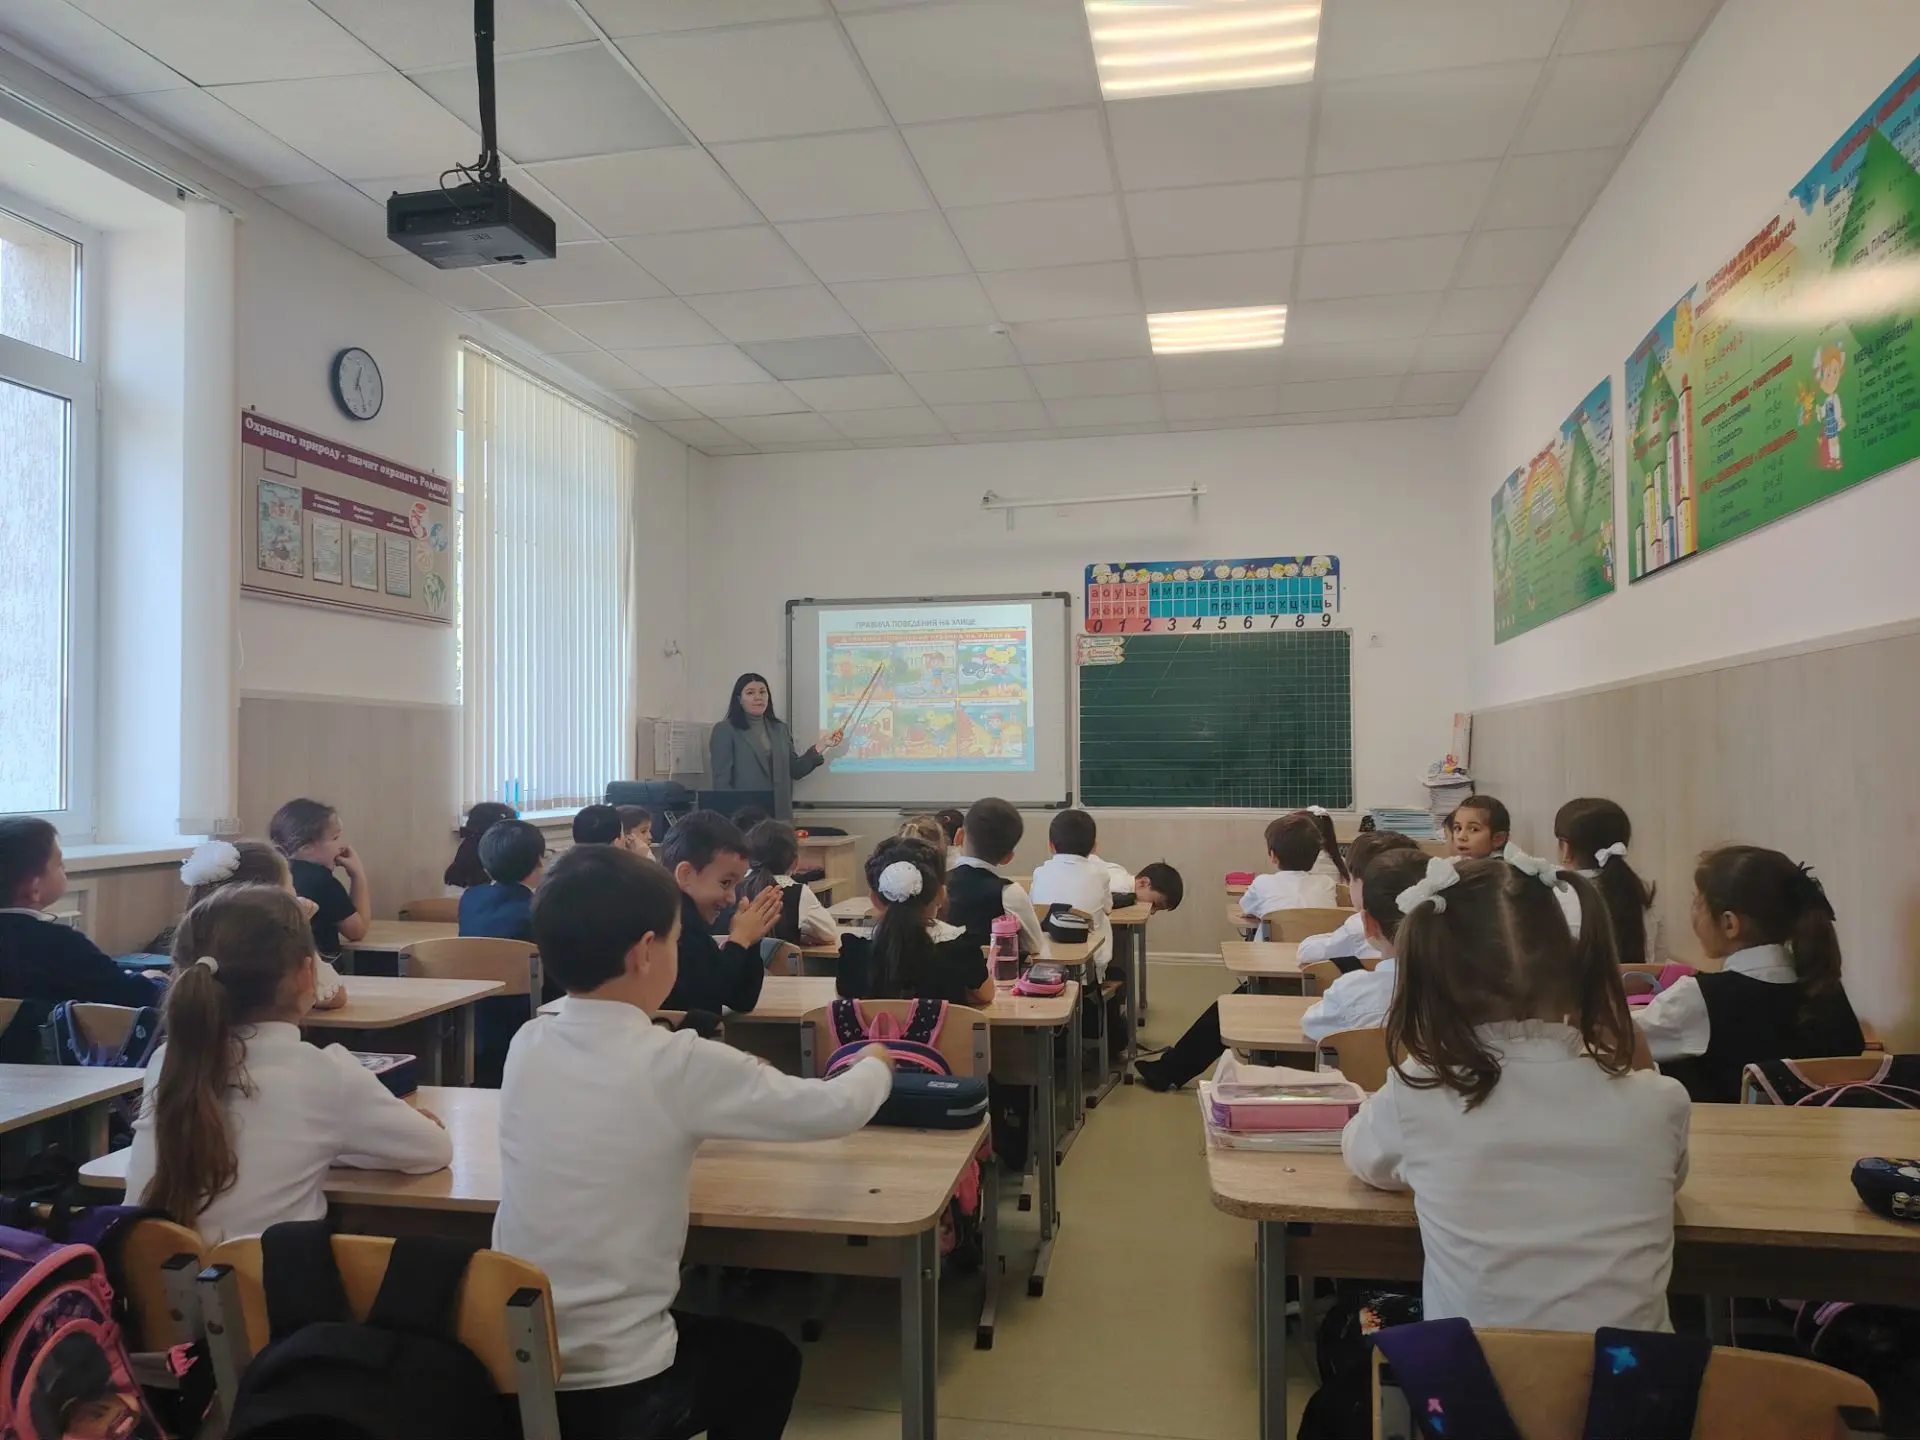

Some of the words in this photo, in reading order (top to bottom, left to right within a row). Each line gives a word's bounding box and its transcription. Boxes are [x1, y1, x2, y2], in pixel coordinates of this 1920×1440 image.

[245, 417, 297, 444] Охранять
[299, 438, 341, 460] природу
[347, 454, 379, 471] значит
[380, 465, 418, 484] охранять
[856, 620, 890, 628] ПРАВИЛА
[892, 619, 937, 628] ПОВЕДЕНИЯ
[1093, 620, 1102, 632] 0
[1119, 619, 1126, 632] 1
[1143, 618, 1152, 632] 2
[1167, 617, 1176, 631] 3
[1192, 617, 1201, 630] 4
[1217, 616, 1227, 629] 5
[1243, 615, 1252, 628] 6
[1270, 615, 1279, 628] 7
[1295, 614, 1305, 627] 8
[1321, 613, 1331, 627] 9
